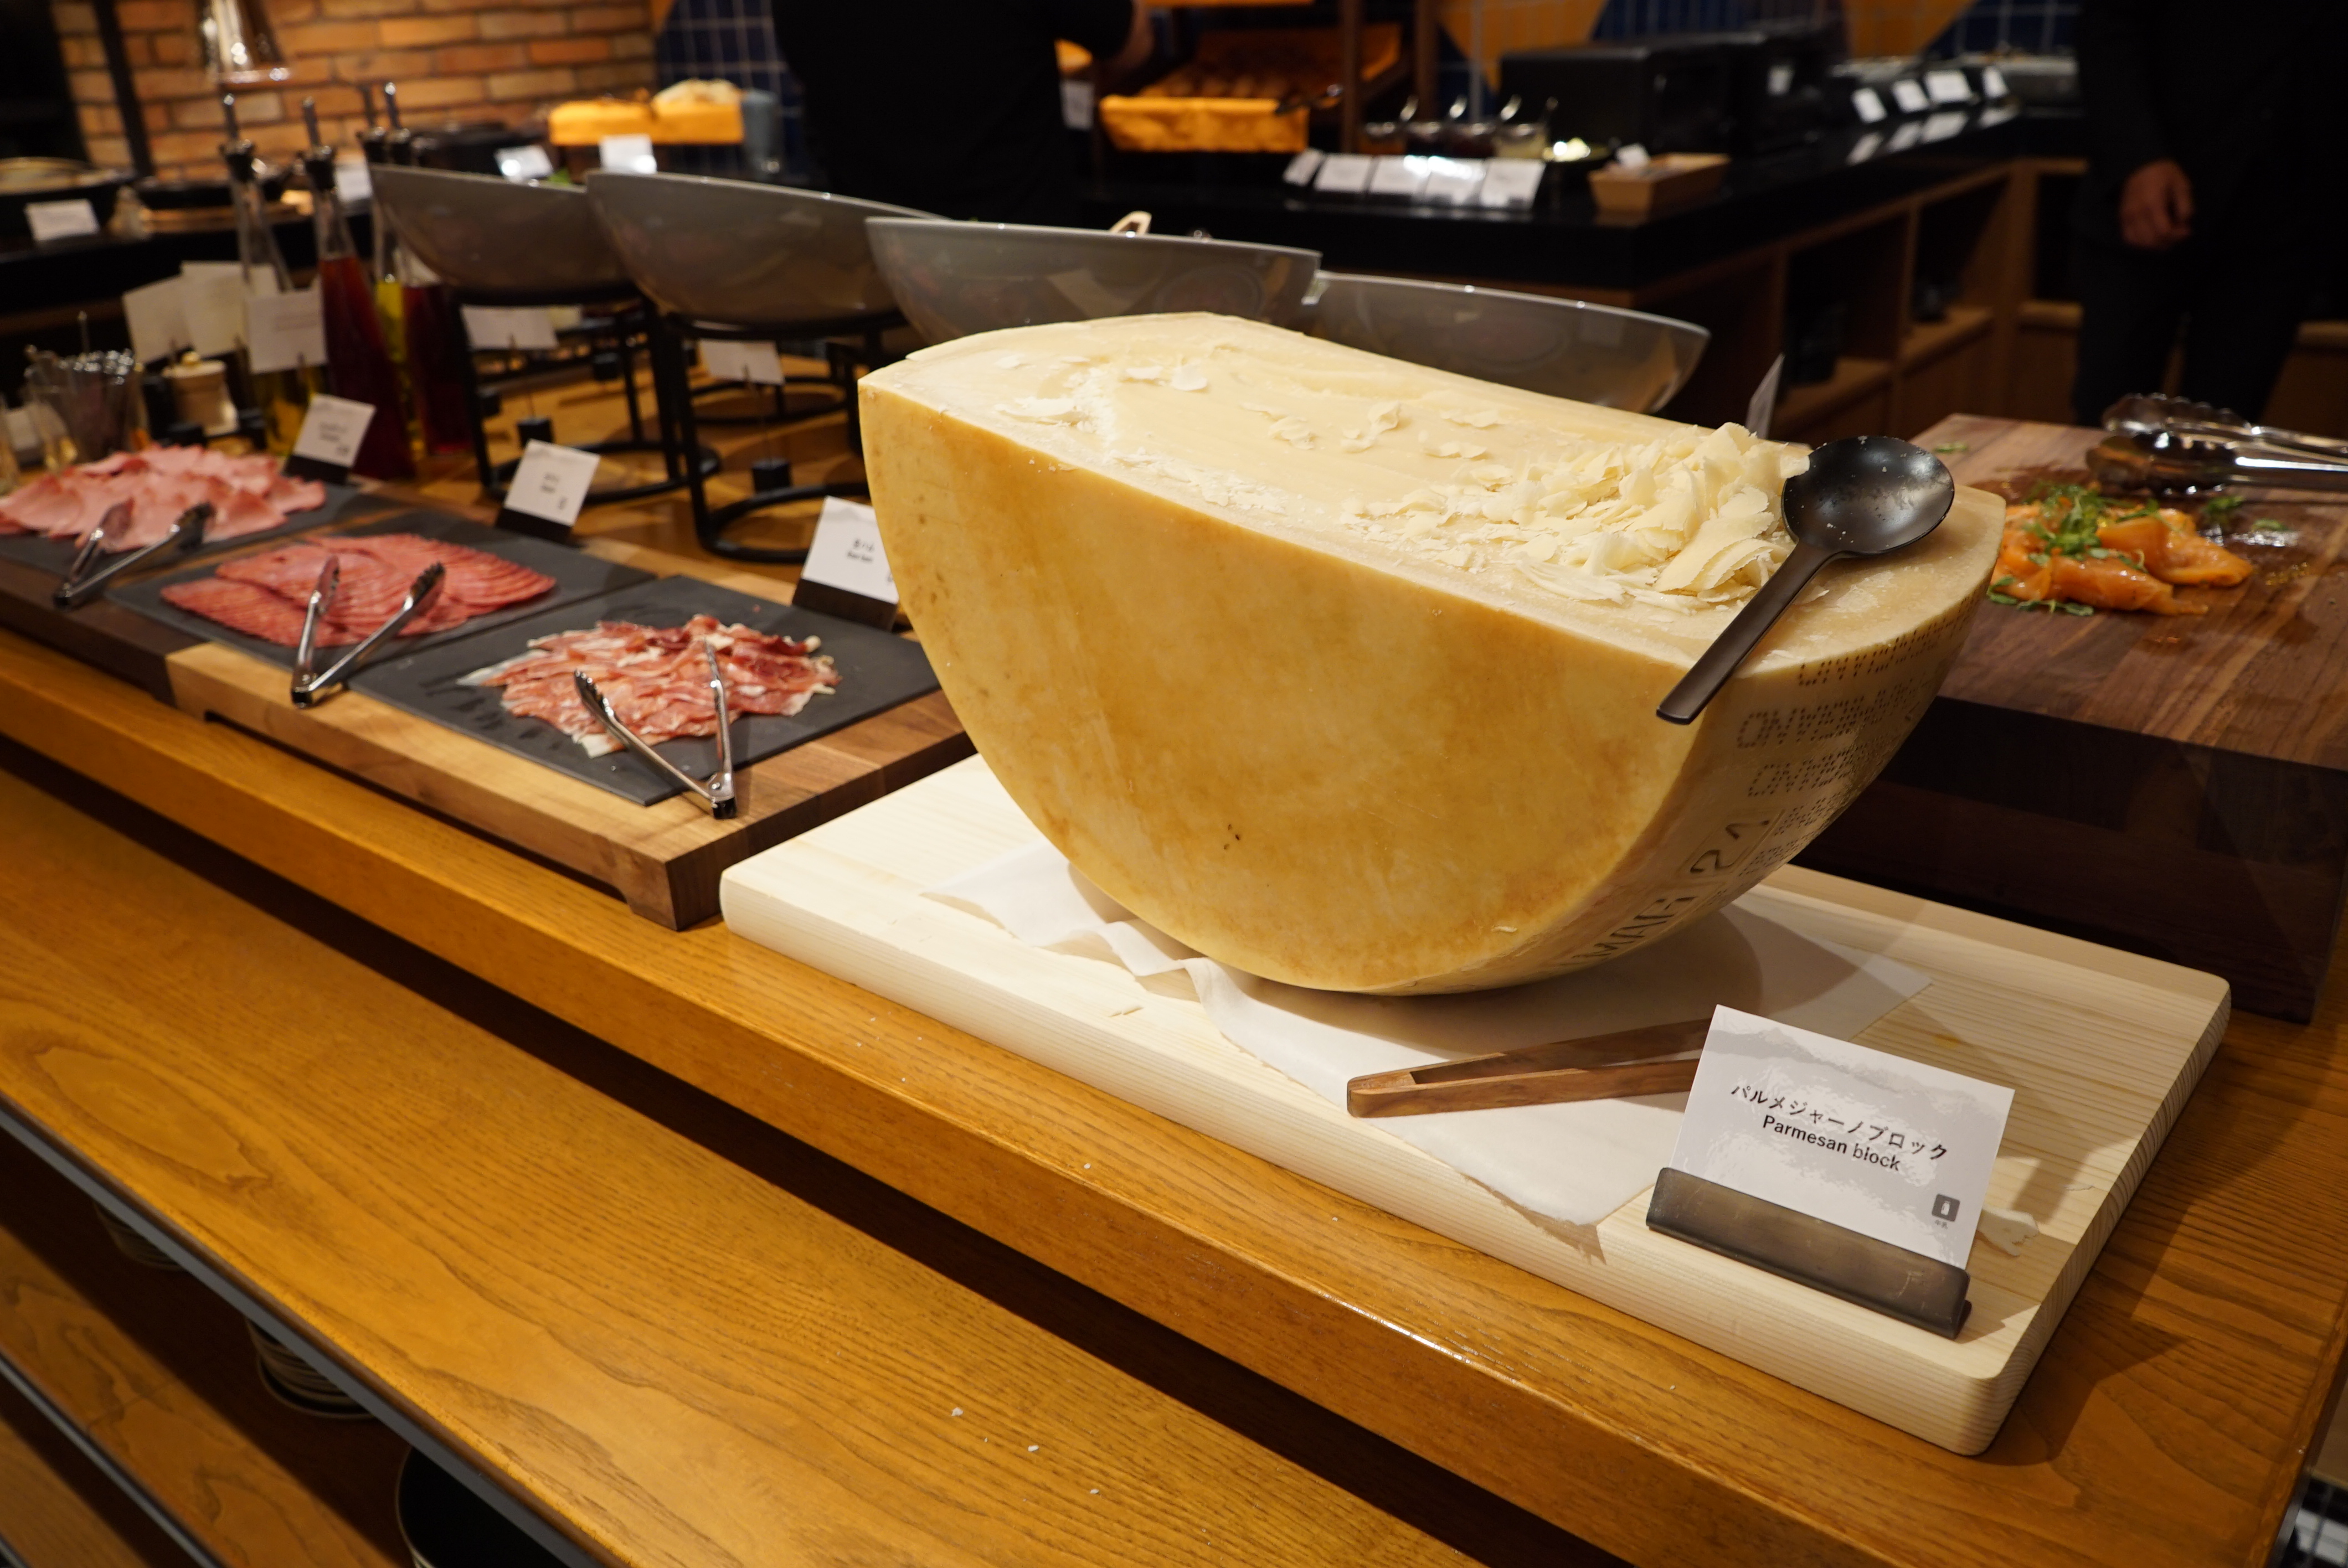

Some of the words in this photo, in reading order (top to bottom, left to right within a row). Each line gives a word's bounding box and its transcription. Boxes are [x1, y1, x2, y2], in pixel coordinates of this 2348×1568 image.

[1731, 1085, 1947, 1160] パルメジャーノブロック
[1763, 1114, 1847, 1154] Parmesan
[1853, 1143, 1901, 1172] block
